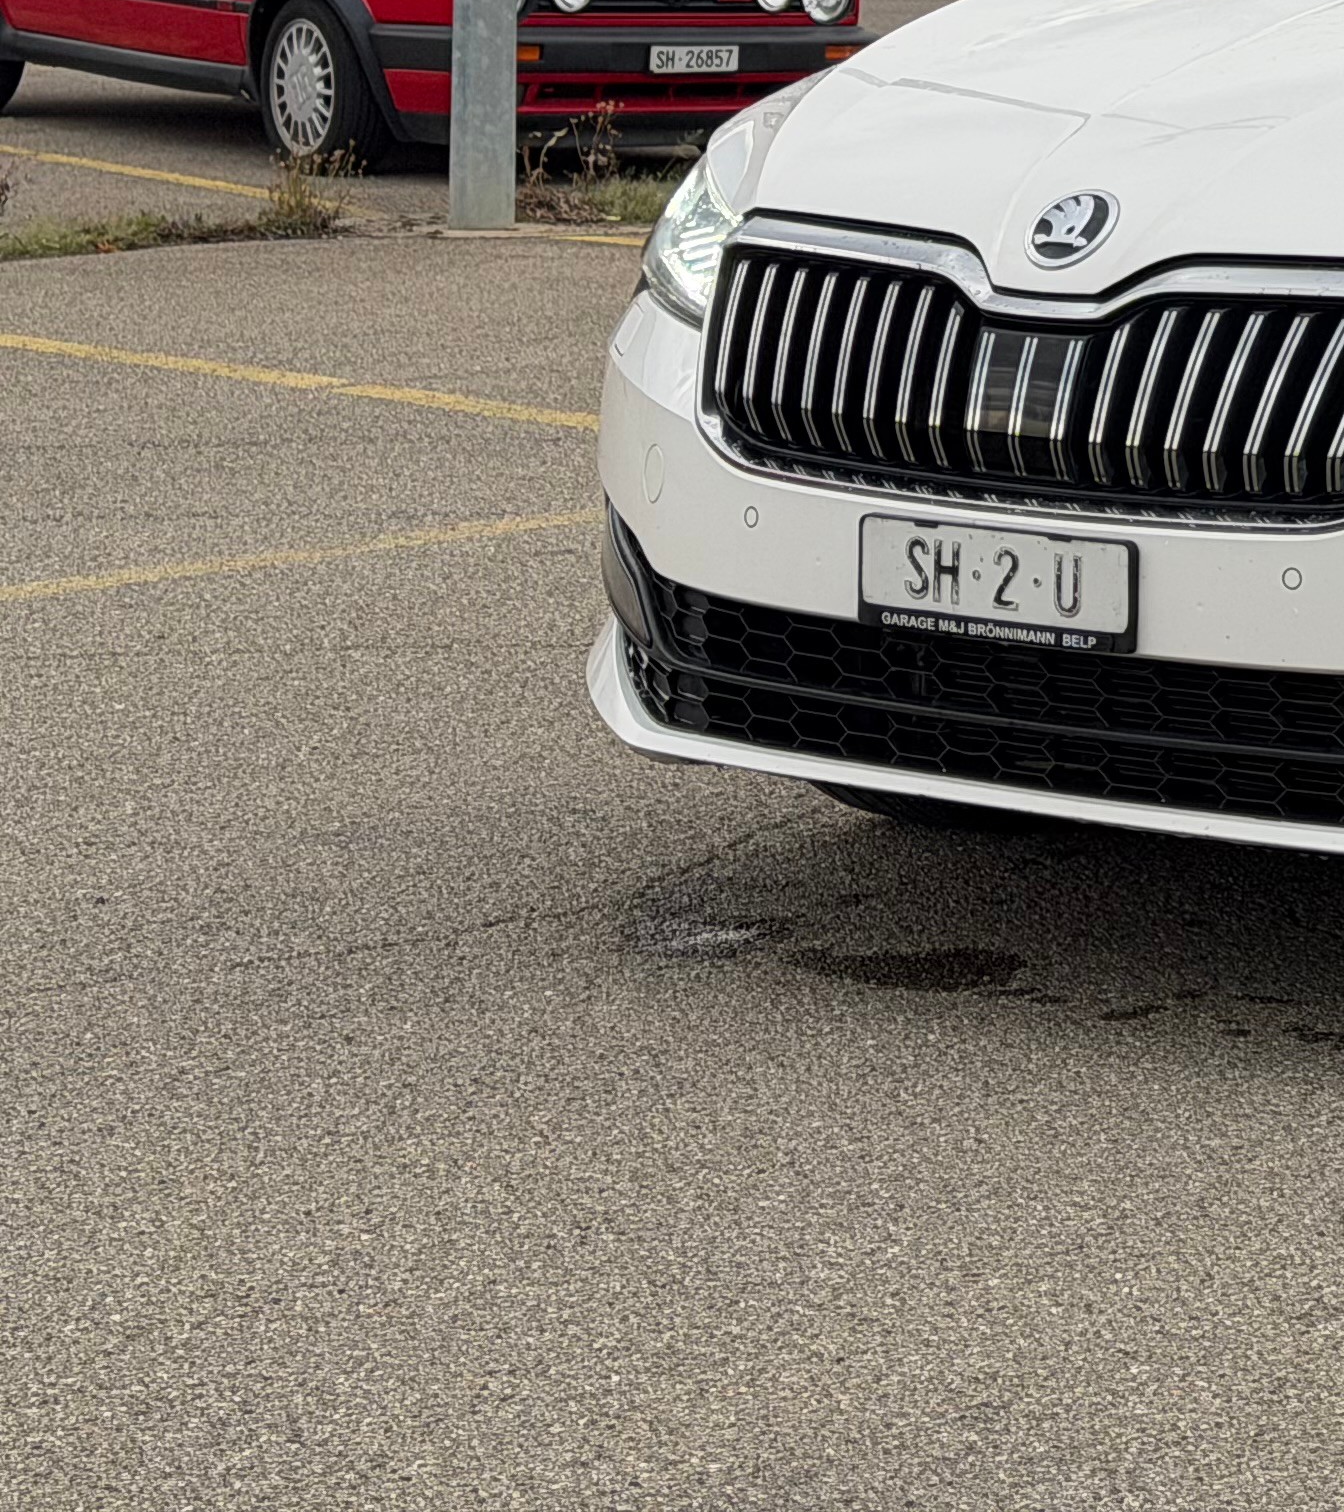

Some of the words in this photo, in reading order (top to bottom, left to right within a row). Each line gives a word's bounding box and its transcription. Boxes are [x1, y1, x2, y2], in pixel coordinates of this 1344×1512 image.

[881, 611, 935, 631] GARAGE
[938, 618, 965, 634] M&J
[968, 622, 1056, 646] BRÖNNIMANN
[1062, 633, 1097, 649] BELP
